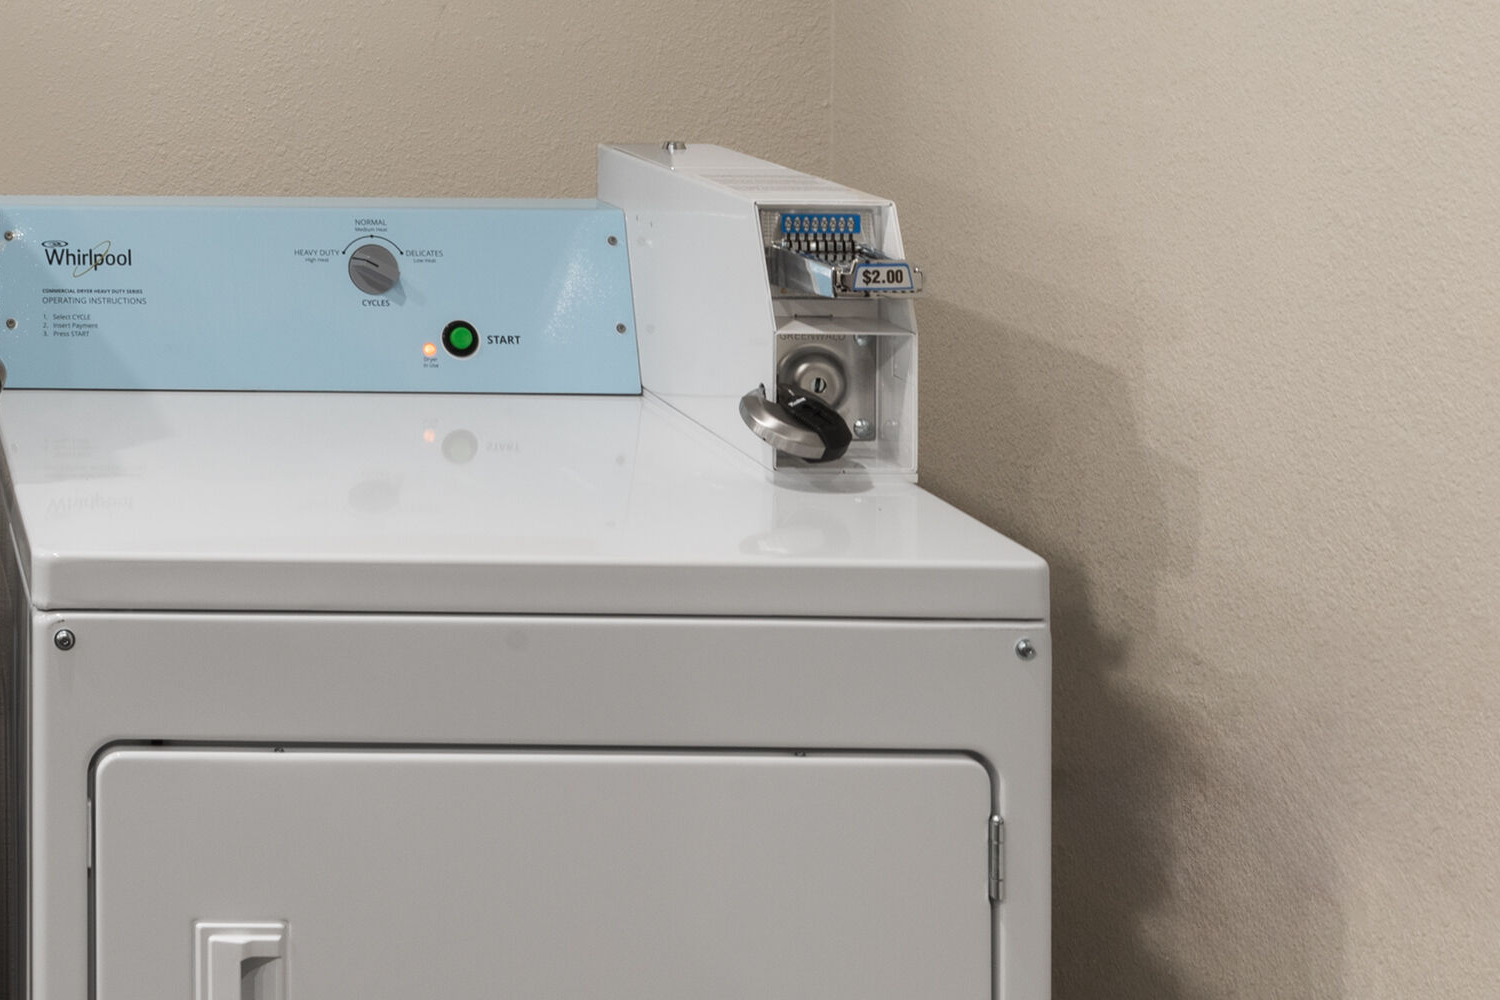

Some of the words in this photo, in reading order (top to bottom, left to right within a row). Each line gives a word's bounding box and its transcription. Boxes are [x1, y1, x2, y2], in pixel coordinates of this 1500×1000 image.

[44, 248, 132, 271] Whirlpool
[862, 269, 903, 285] $2.00
[42, 297, 87, 305] OPERATING
[88, 297, 147, 305] INSTRUCTIONS
[362, 299, 391, 307] CYCLES
[71, 322, 98, 330] Payment
[486, 335, 521, 345] START
[779, 333, 846, 341] GREENWALD
